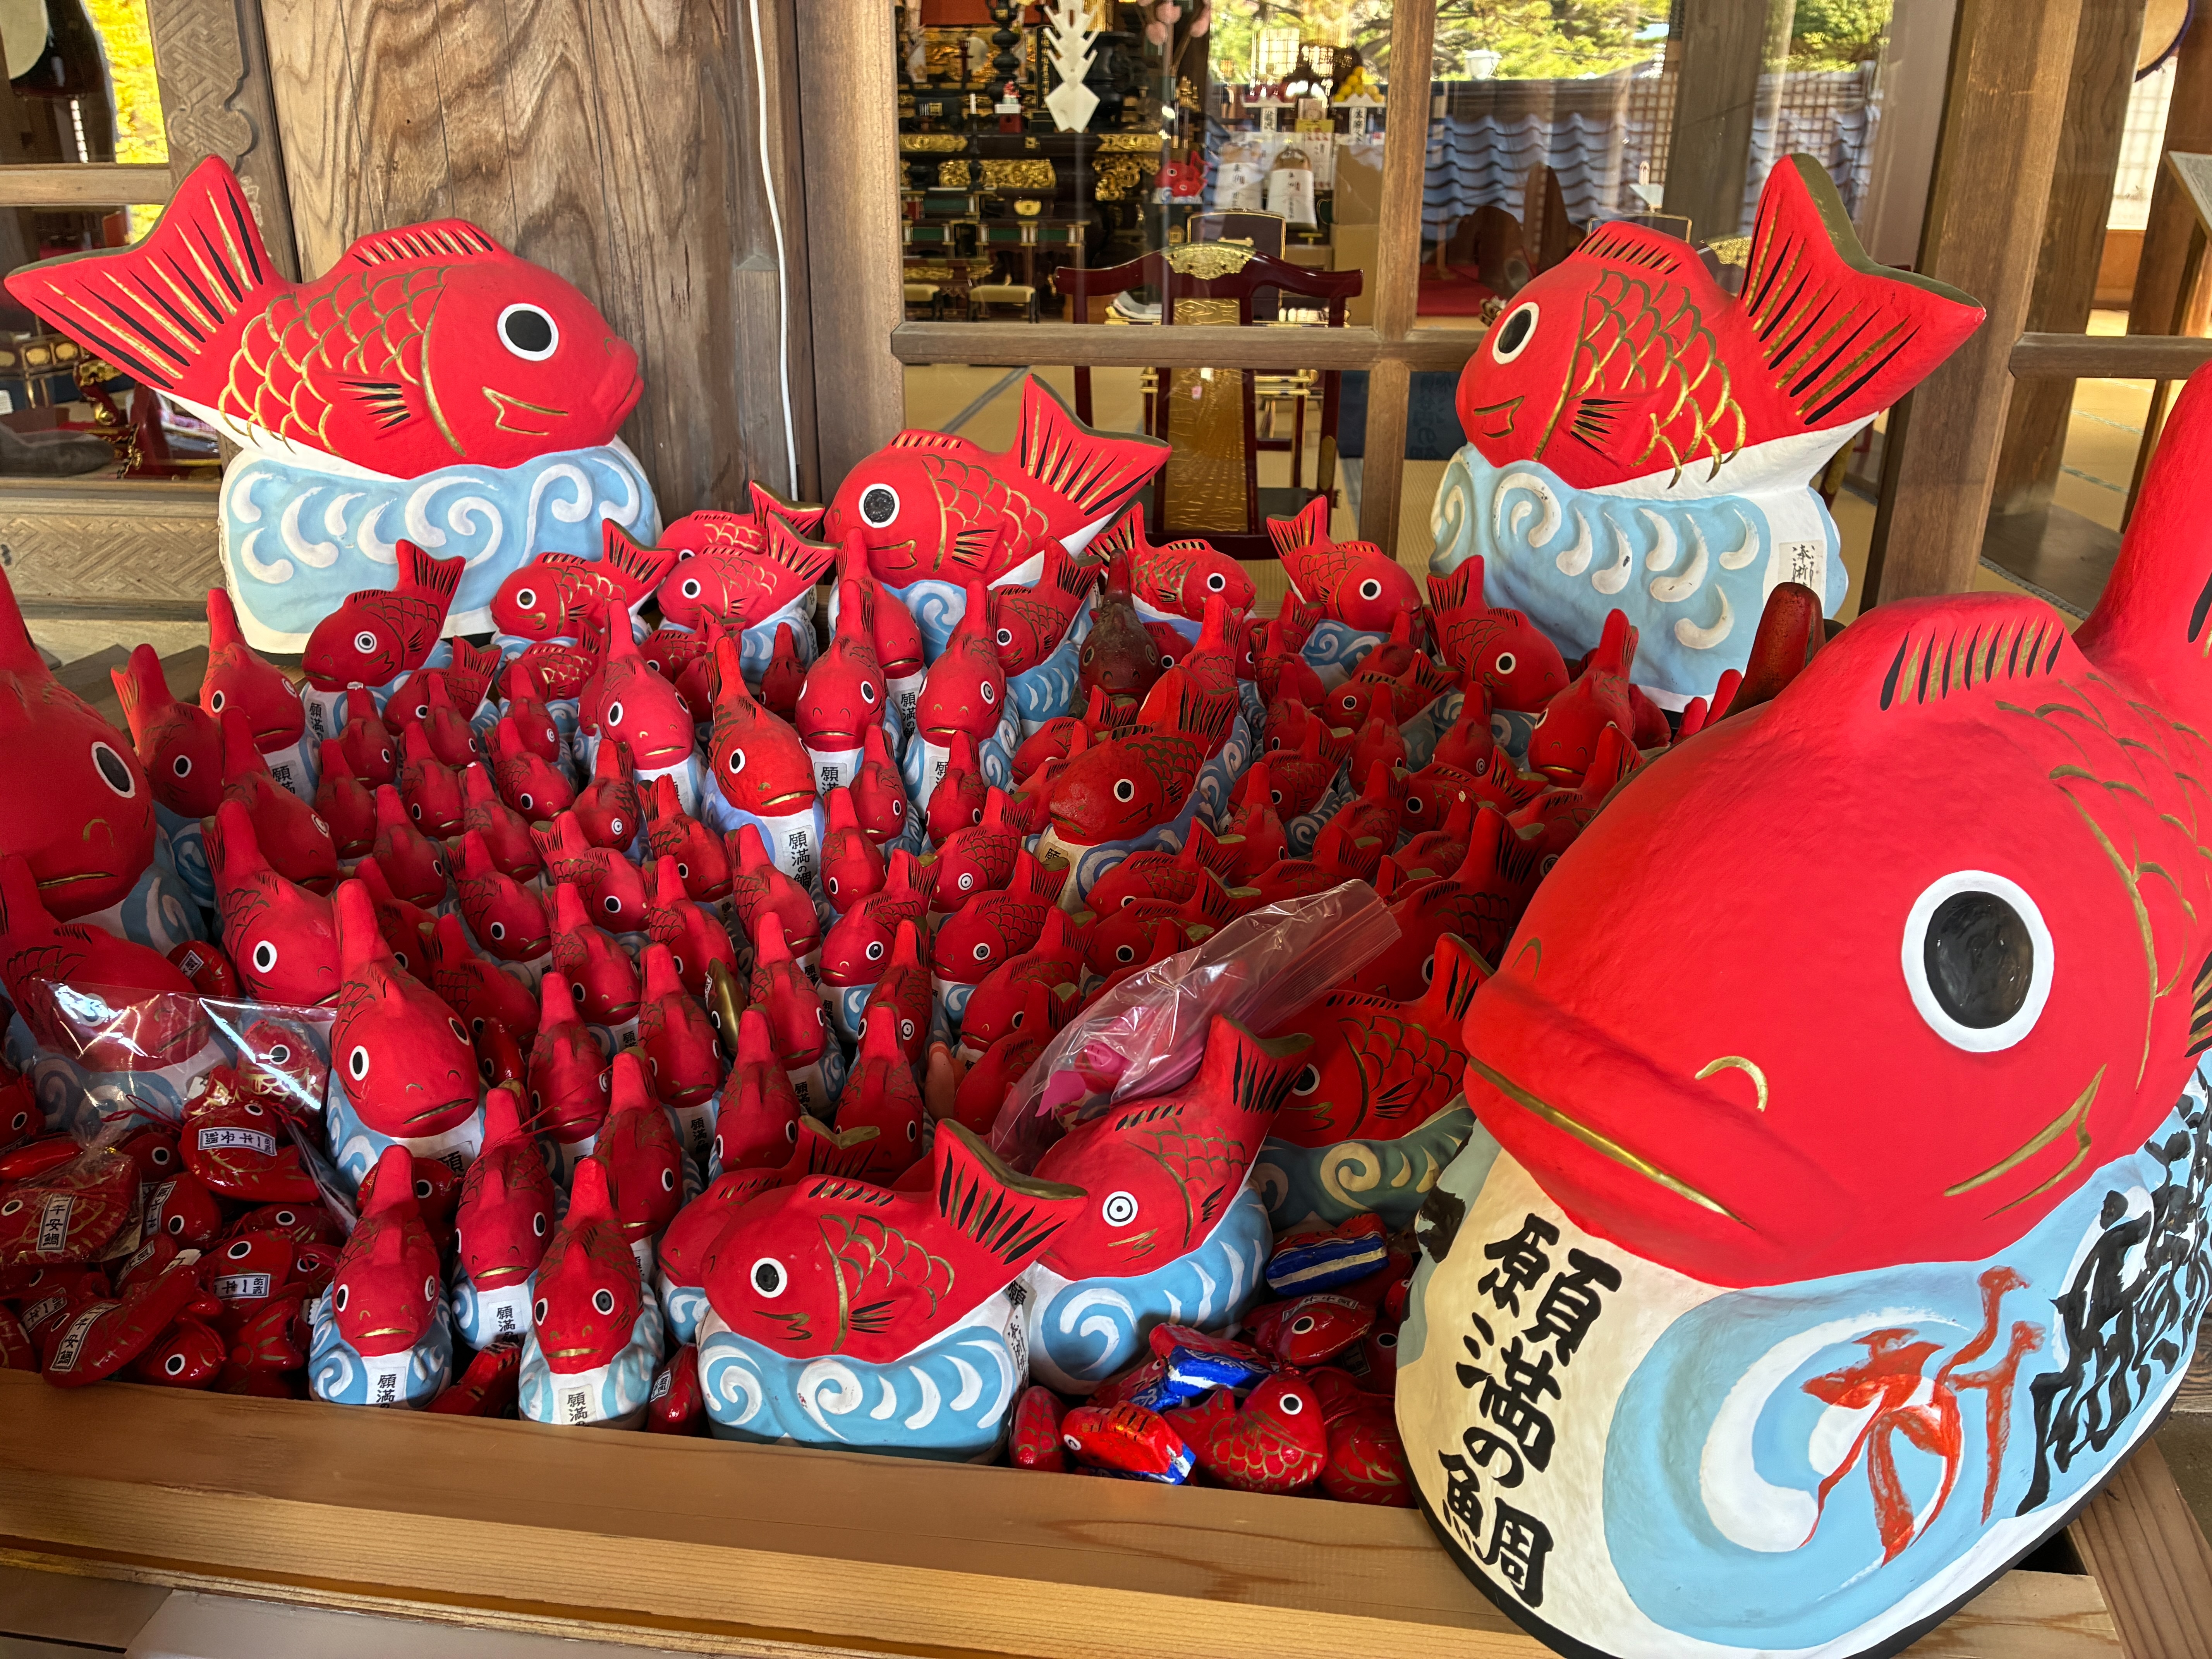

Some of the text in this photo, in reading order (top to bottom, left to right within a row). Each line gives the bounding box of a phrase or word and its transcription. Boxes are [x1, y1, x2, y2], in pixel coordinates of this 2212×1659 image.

[205, 1131, 260, 1147] 一年安鯛
[1438, 1213, 1622, 1609] 願満の鯛
